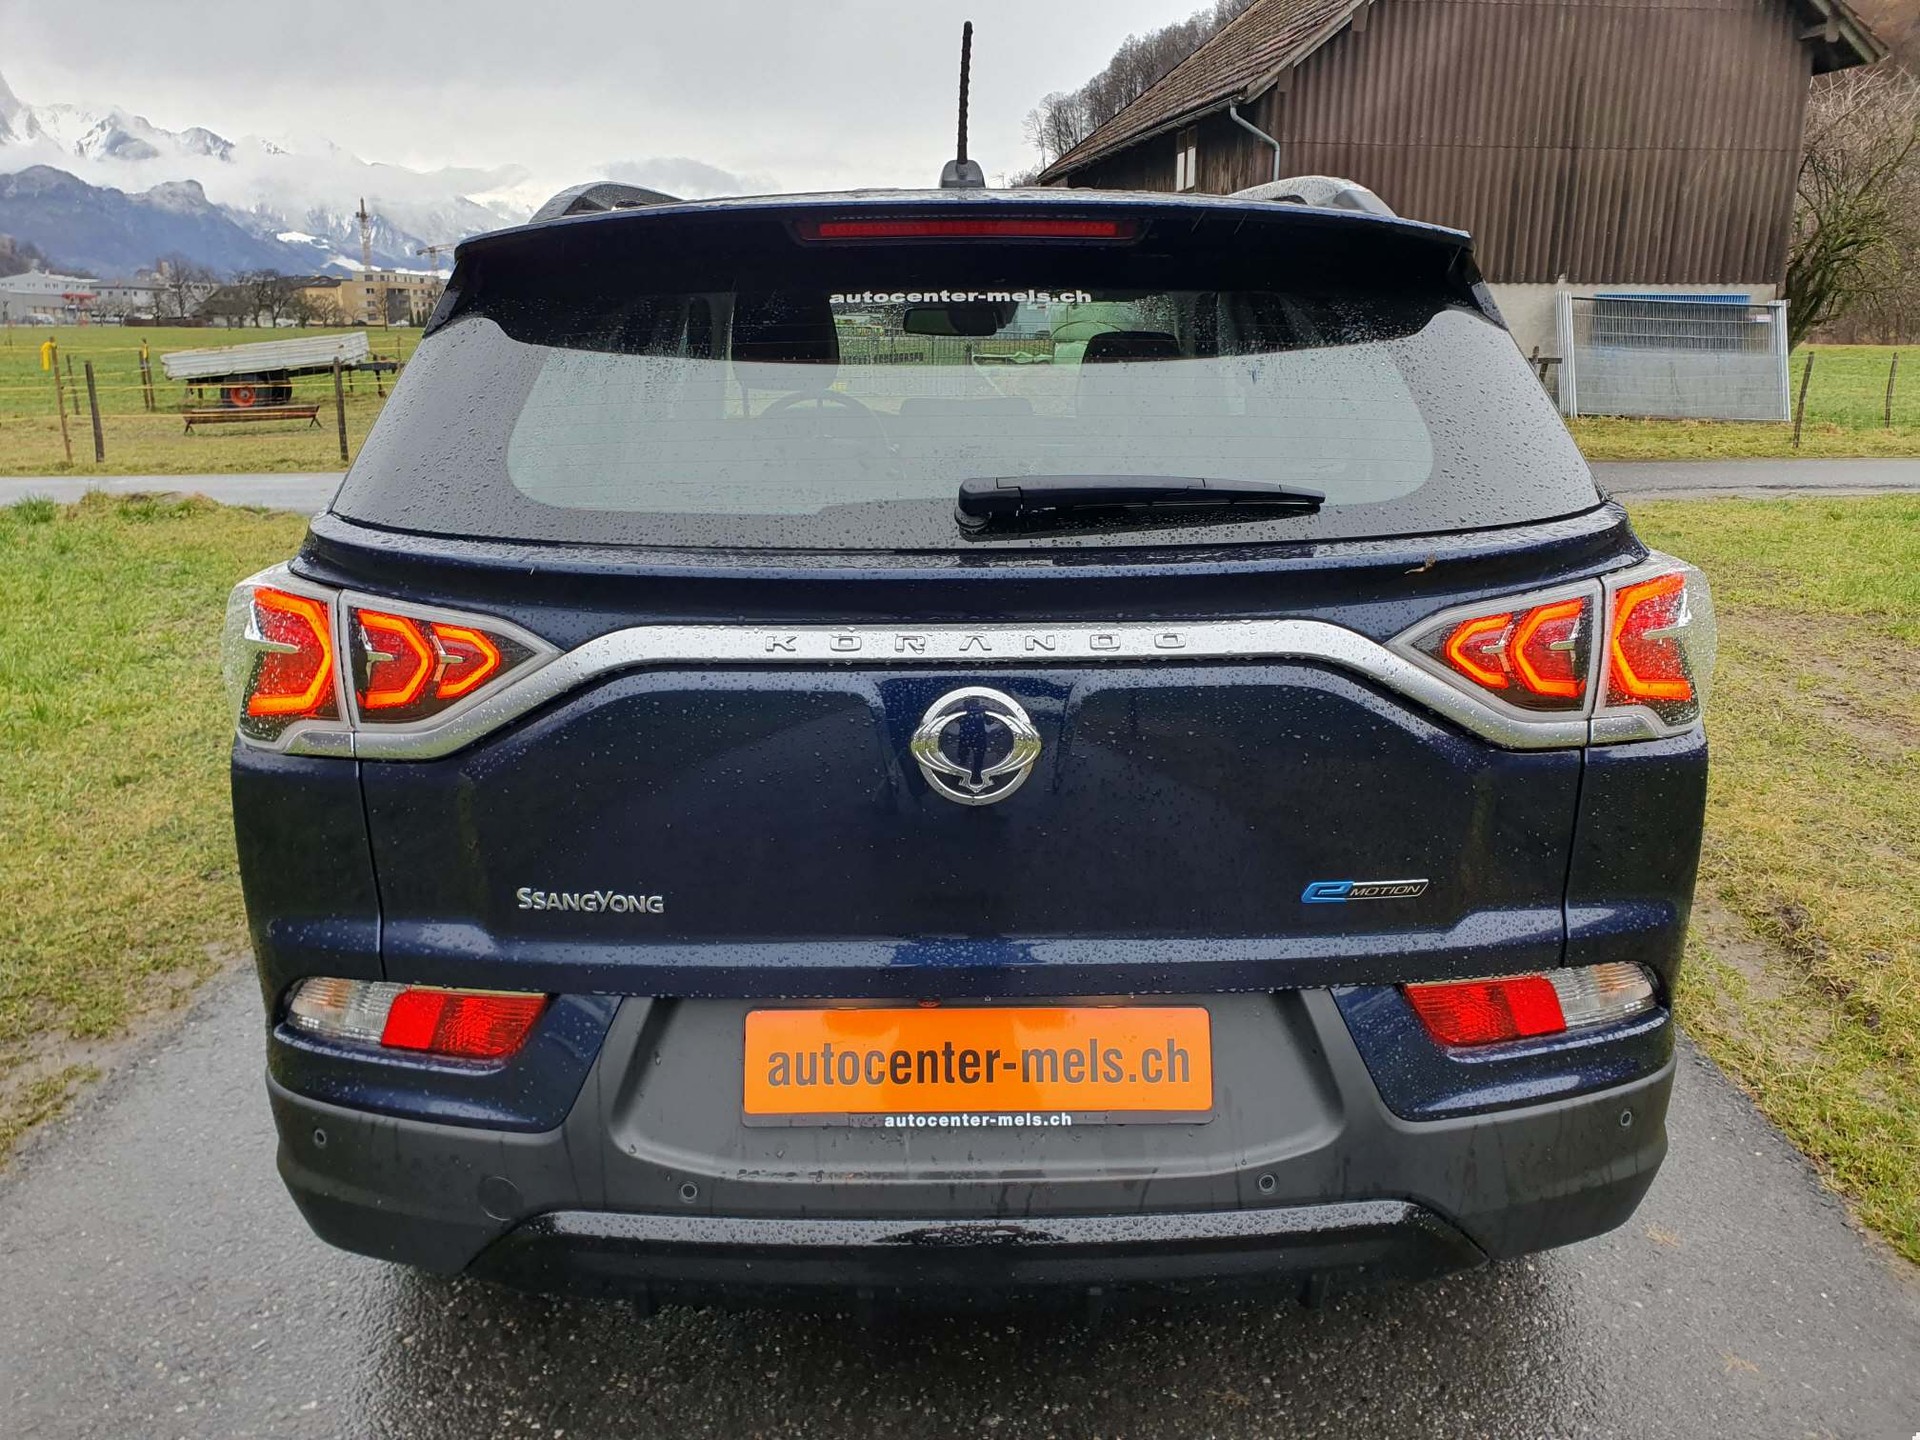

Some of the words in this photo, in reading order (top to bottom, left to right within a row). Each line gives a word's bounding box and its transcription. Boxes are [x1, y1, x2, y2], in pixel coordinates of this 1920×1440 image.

[829, 289, 1092, 304] autocenter-mels.ch
[764, 632, 1187, 653] KORANDO
[768, 1038, 1191, 1087] autocenter-mels.ch
[884, 1112, 1073, 1128] autocenter-mels.ch
